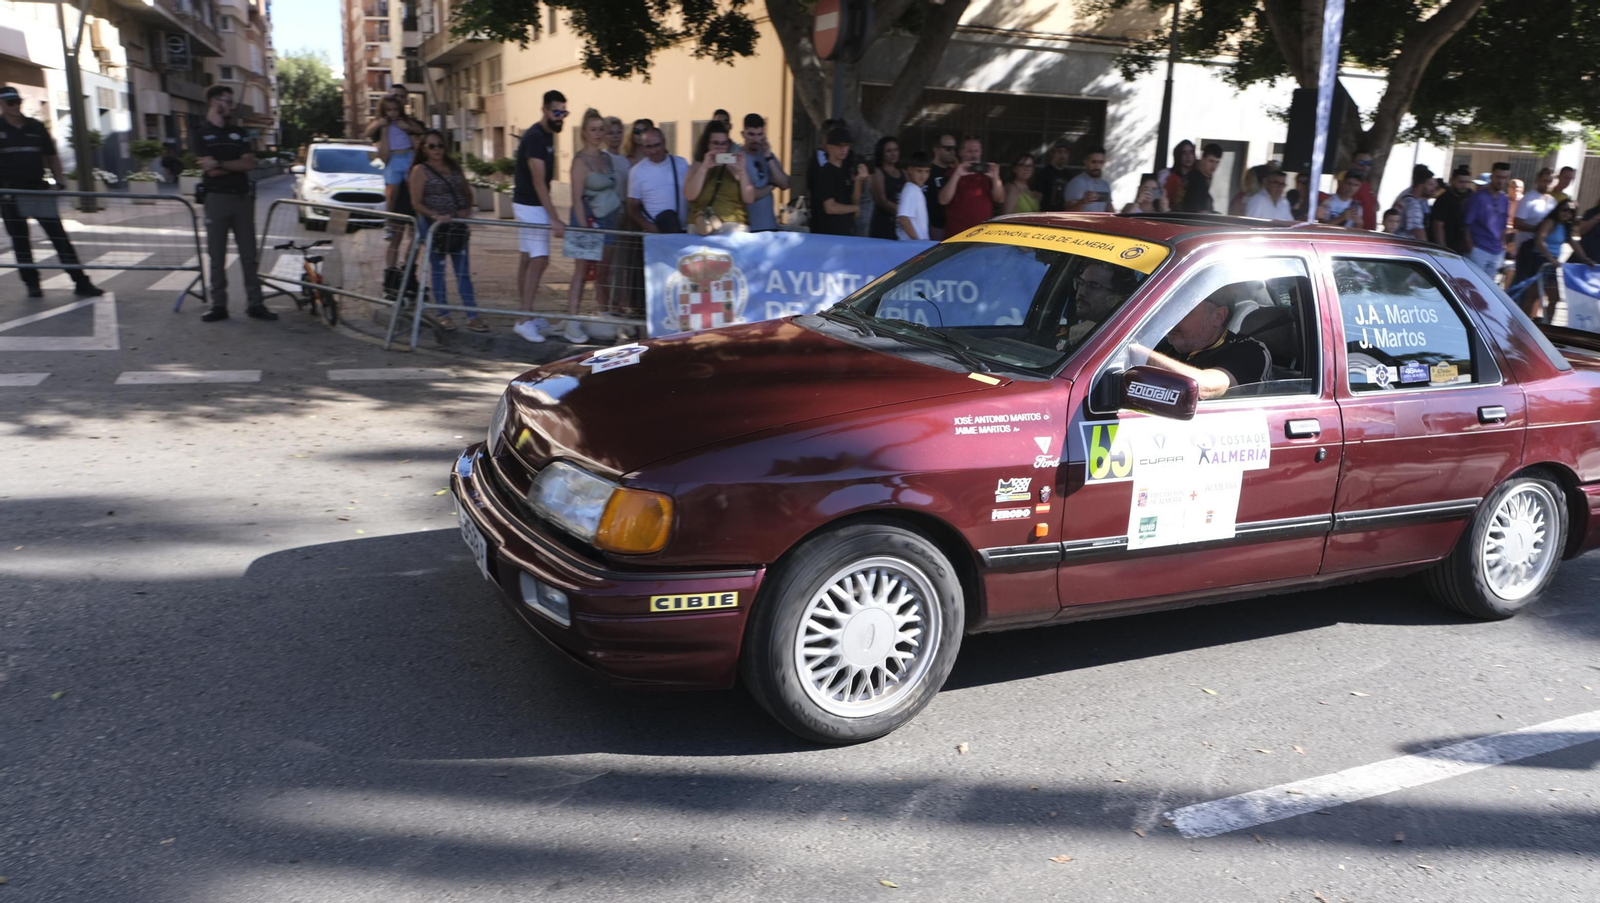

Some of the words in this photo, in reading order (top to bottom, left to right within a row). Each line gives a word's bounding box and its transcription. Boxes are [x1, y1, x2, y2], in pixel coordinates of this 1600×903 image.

[985, 229, 1030, 239] AUTOMÓVIL
[1032, 233, 1057, 241] CLUB
[1070, 239, 1116, 252] ALMERÍA
[1355, 304, 1384, 325] J.A.
[1385, 304, 1438, 324] Martos
[1359, 328, 1373, 349] J.
[1373, 328, 1427, 348] Martos
[954, 415, 974, 425] JOSÉ
[974, 414, 1010, 424] ANTONIO
[1010, 413, 1041, 422] MARTOS
[955, 426, 978, 435] JAIME
[979, 425, 1011, 434] MARTOS
[1221, 435, 1252, 445] COSTA
[1255, 433, 1267, 443] DE
[1090, 425, 1133, 479] 65
[1211, 444, 1267, 464] ALMERÍA
[1034, 455, 1060, 468] Ford
[1139, 455, 1184, 466] CUPRA
[655, 594, 734, 610] CIBIE
